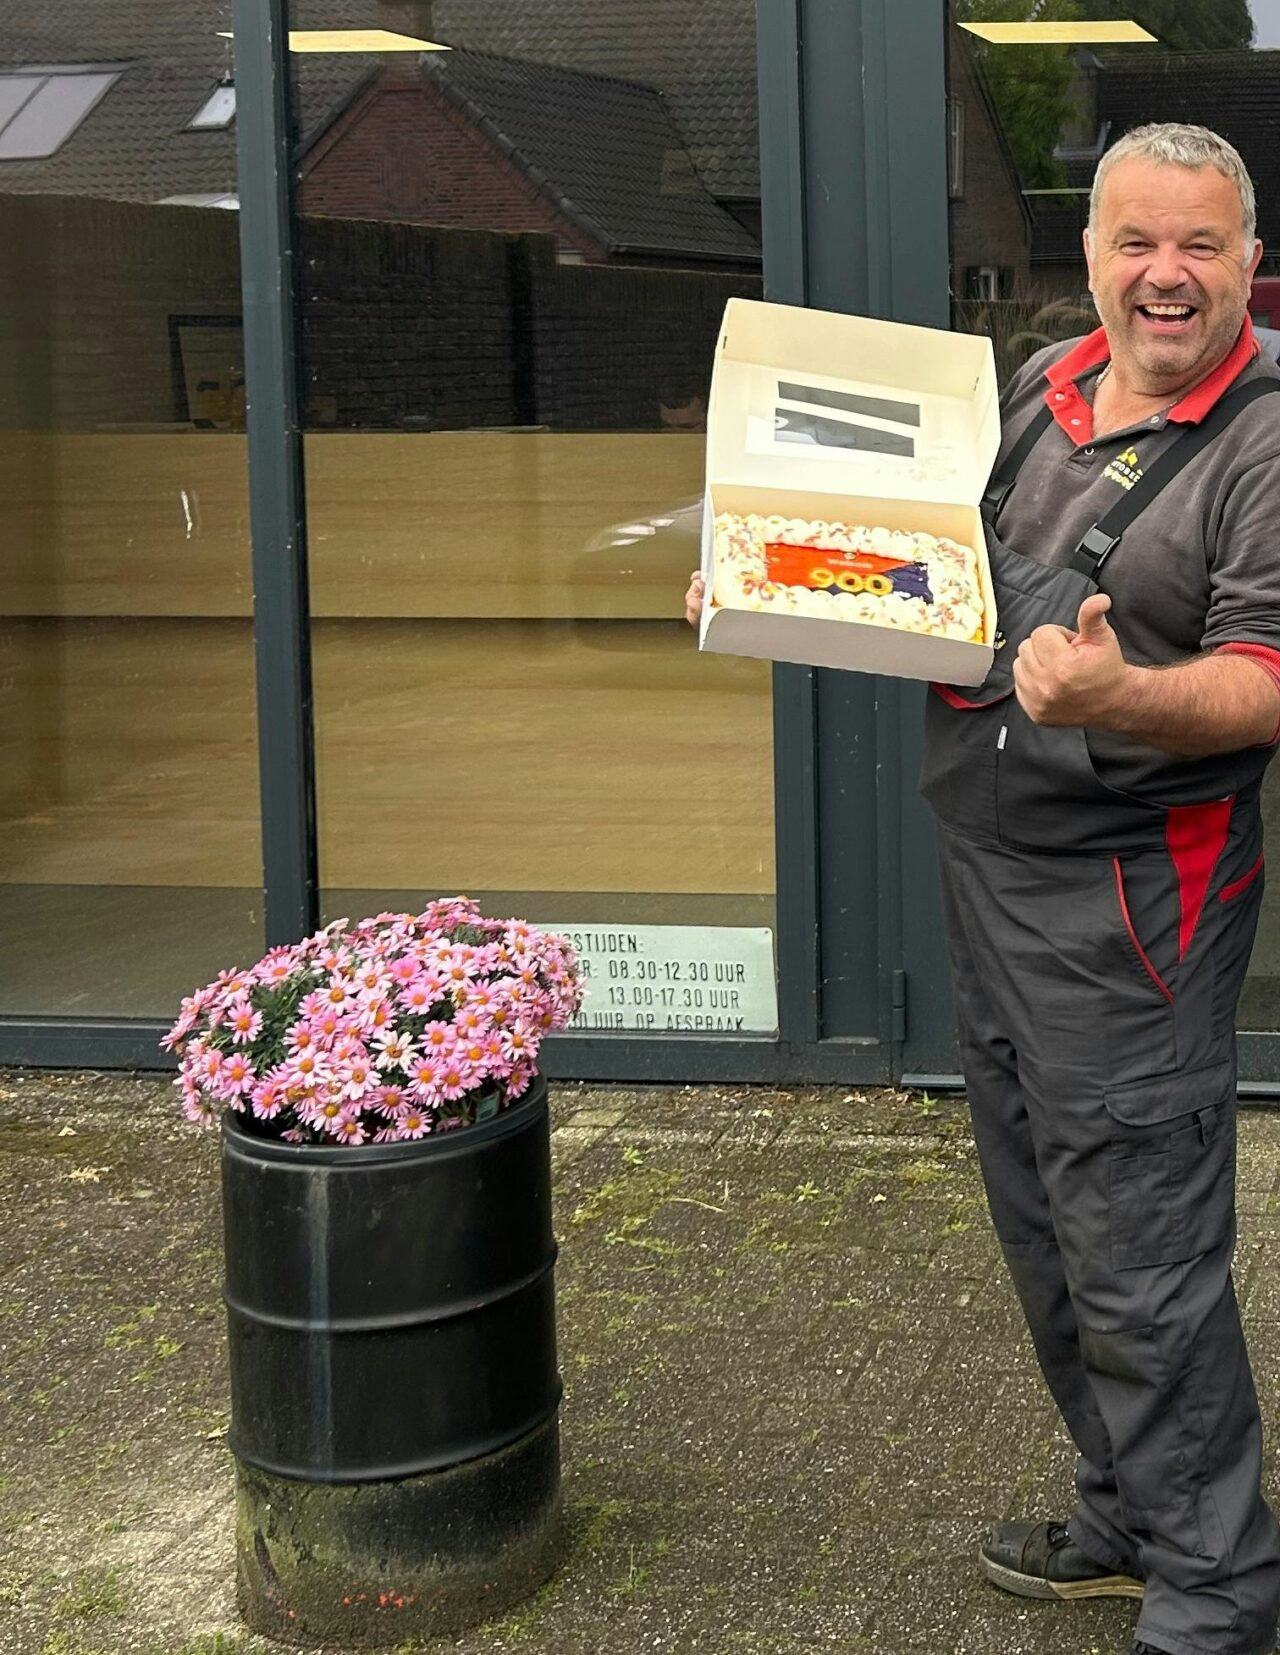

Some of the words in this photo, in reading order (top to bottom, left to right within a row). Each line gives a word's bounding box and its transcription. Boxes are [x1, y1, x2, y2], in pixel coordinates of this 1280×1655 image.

[609, 959, 708, 982] 08.30-12.30
[715, 963, 745, 983] UUR
[608, 986, 703, 1008] 13.00-17.30
[709, 989, 740, 1009] UUR
[636, 1013, 655, 1031] OP
